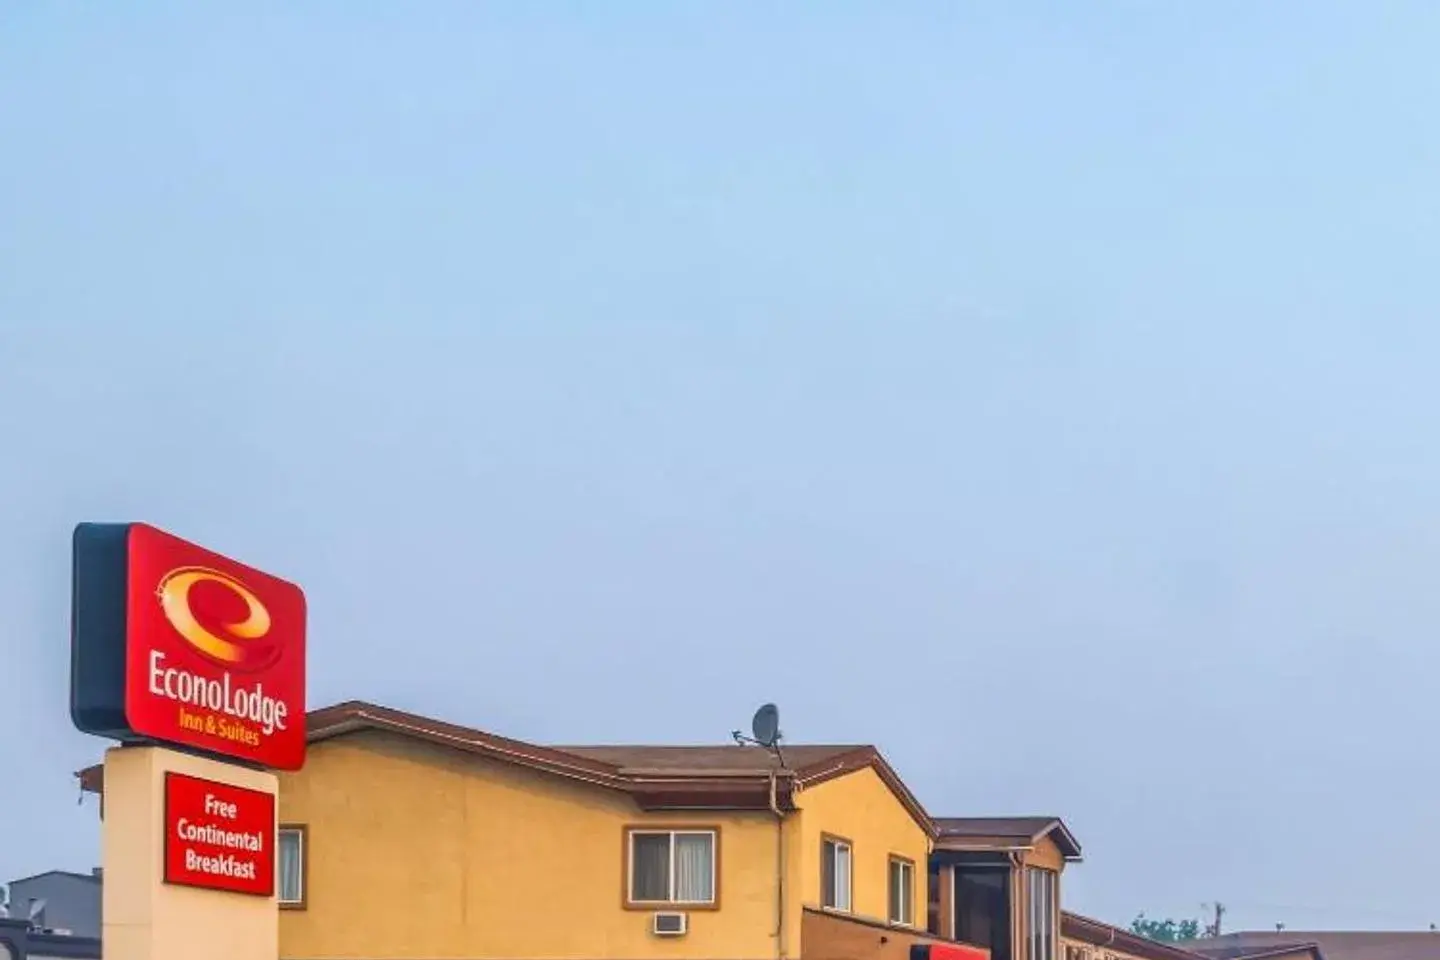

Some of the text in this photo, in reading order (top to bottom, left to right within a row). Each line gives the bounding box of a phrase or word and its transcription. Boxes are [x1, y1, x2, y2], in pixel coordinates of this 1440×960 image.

[149, 648, 287, 735] EconoLodge
[180, 708, 259, 746] Inn & Suites
[205, 793, 237, 819] Free
[177, 817, 262, 851] Continental
[185, 848, 256, 879] Breakfast
